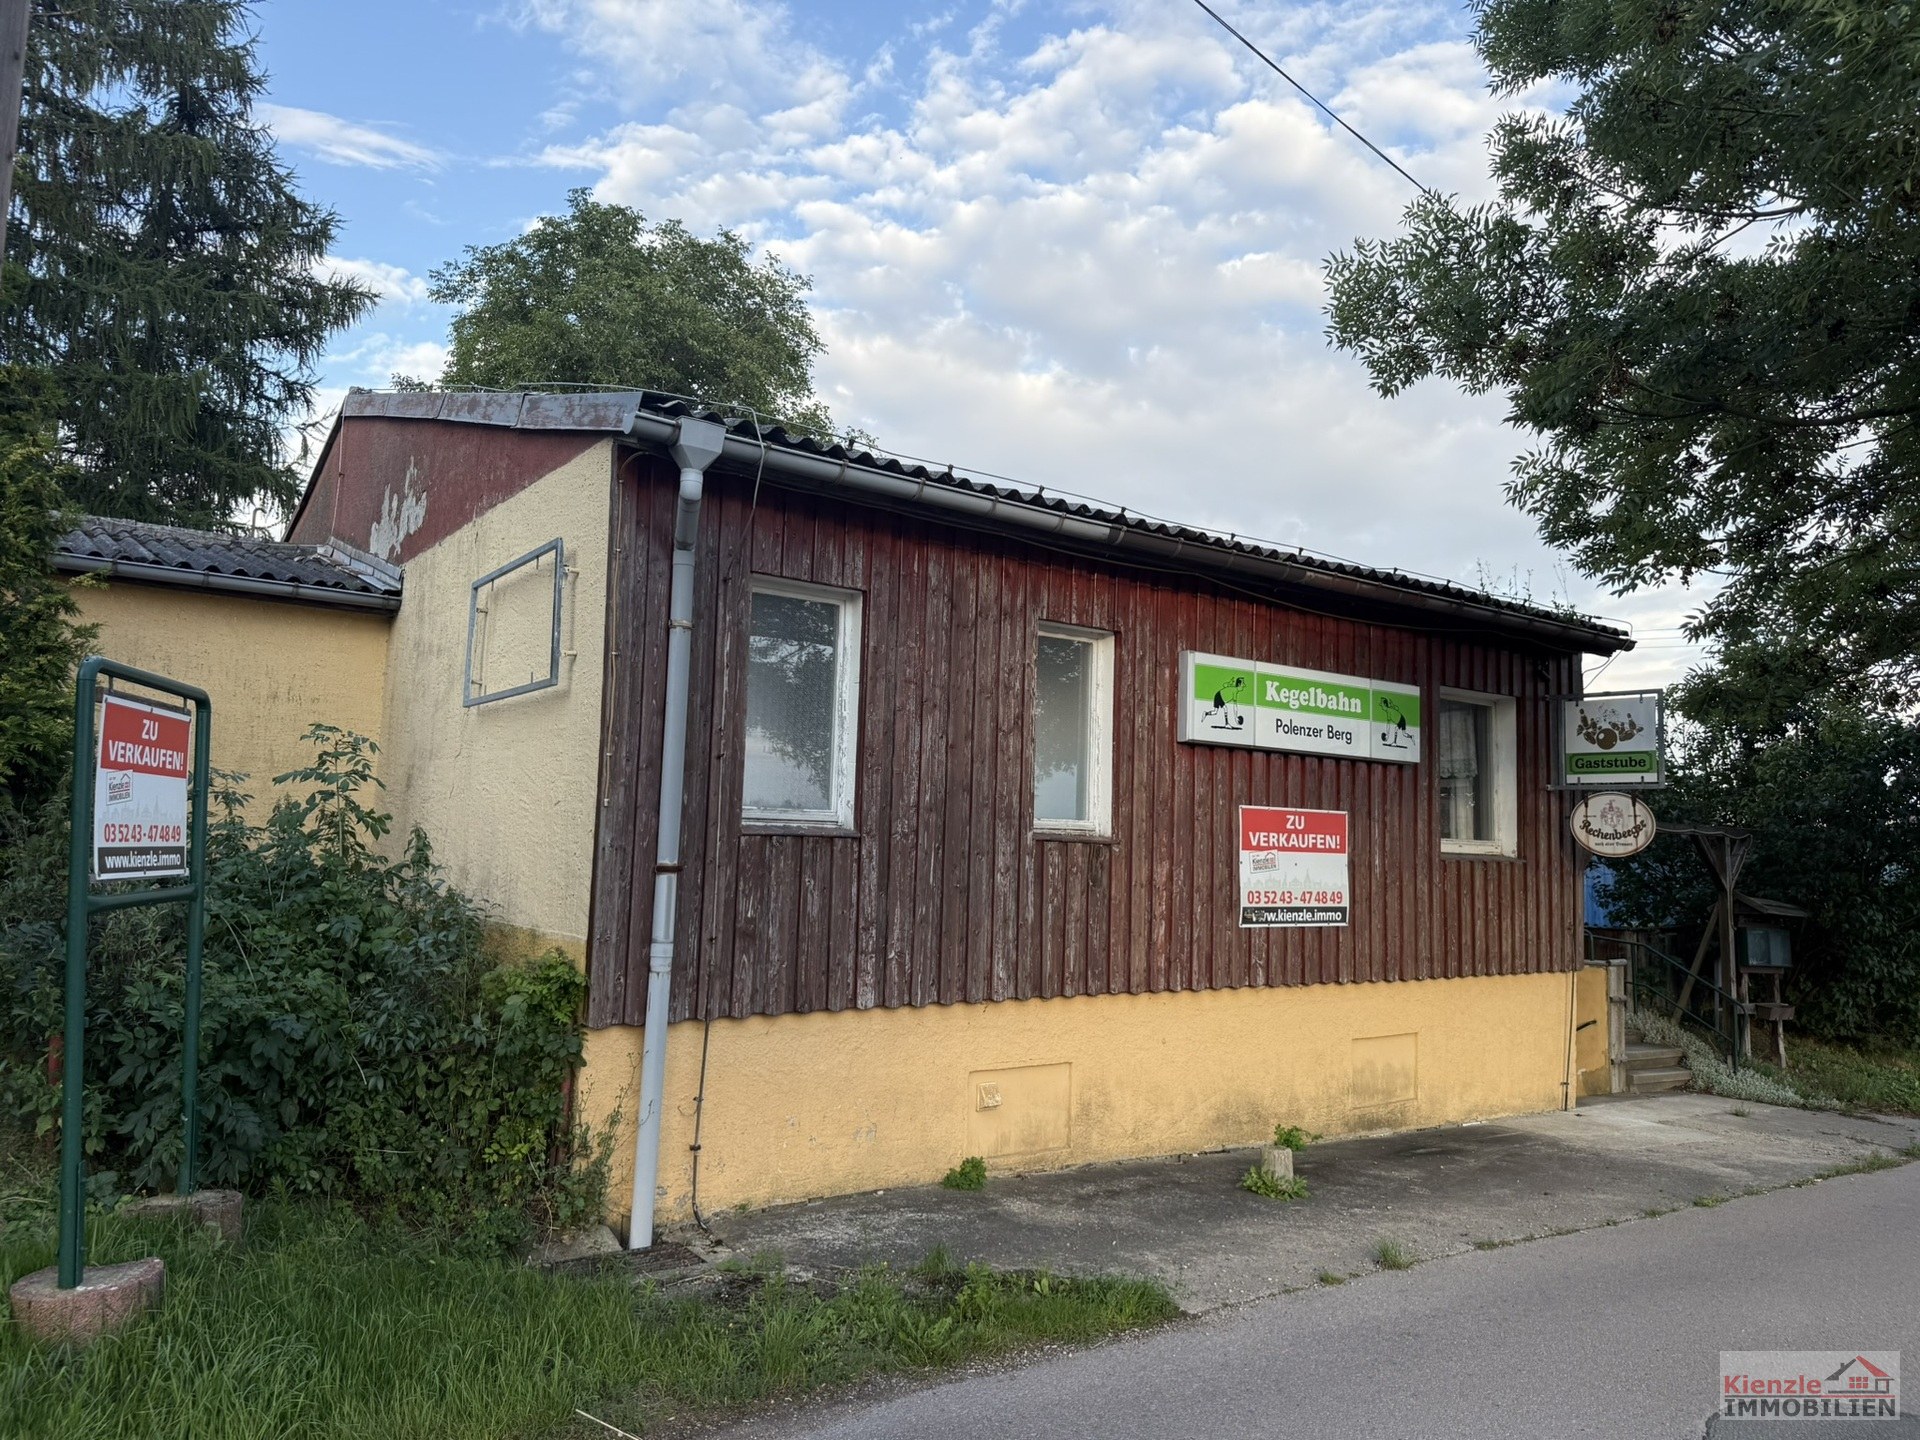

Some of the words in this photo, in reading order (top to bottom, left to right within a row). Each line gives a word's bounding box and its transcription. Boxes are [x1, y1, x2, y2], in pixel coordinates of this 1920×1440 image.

[1265, 680, 1362, 713] Kegelbahn
[141, 718, 158, 741] ZU
[1275, 718, 1323, 739] Polenzer
[1327, 724, 1353, 745] Berg
[108, 740, 184, 771] VERKAUFEN!
[1575, 756, 1647, 769] Gaststube
[1286, 815, 1305, 830] ZU
[1249, 831, 1340, 849] VERKAUFEN!
[104, 850, 181, 869] www.kienzle.immo
[1250, 908, 1342, 922] w.kienzle.immo
